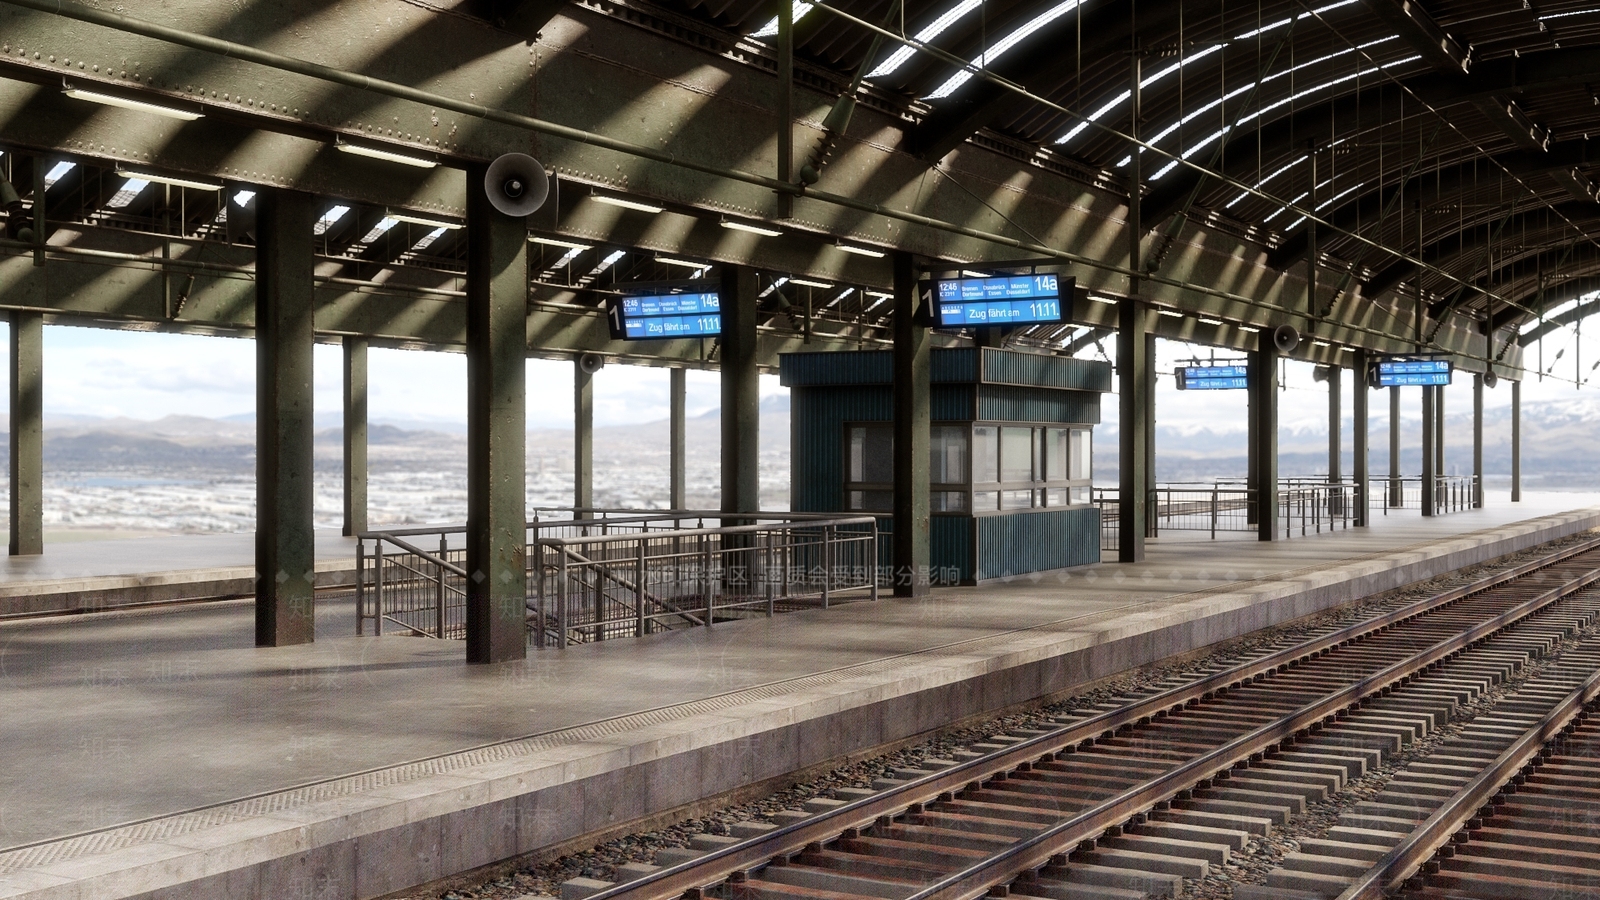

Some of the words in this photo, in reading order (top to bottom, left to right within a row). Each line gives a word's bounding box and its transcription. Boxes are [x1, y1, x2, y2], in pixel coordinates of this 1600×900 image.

[940, 283, 957, 291] 12:46
[1035, 276, 1058, 291] 14a
[701, 294, 719, 308] 14a
[922, 289, 934, 317] 1
[610, 305, 620, 330] 1
[969, 309, 986, 320] Zug
[988, 308, 1006, 318] fährt
[1030, 302, 1059, 317] 11.11.
[649, 323, 662, 333] Zug
[664, 323, 679, 331] fährt
[1370, 366, 1376, 381] 1
[1435, 362, 1449, 370] 14a
